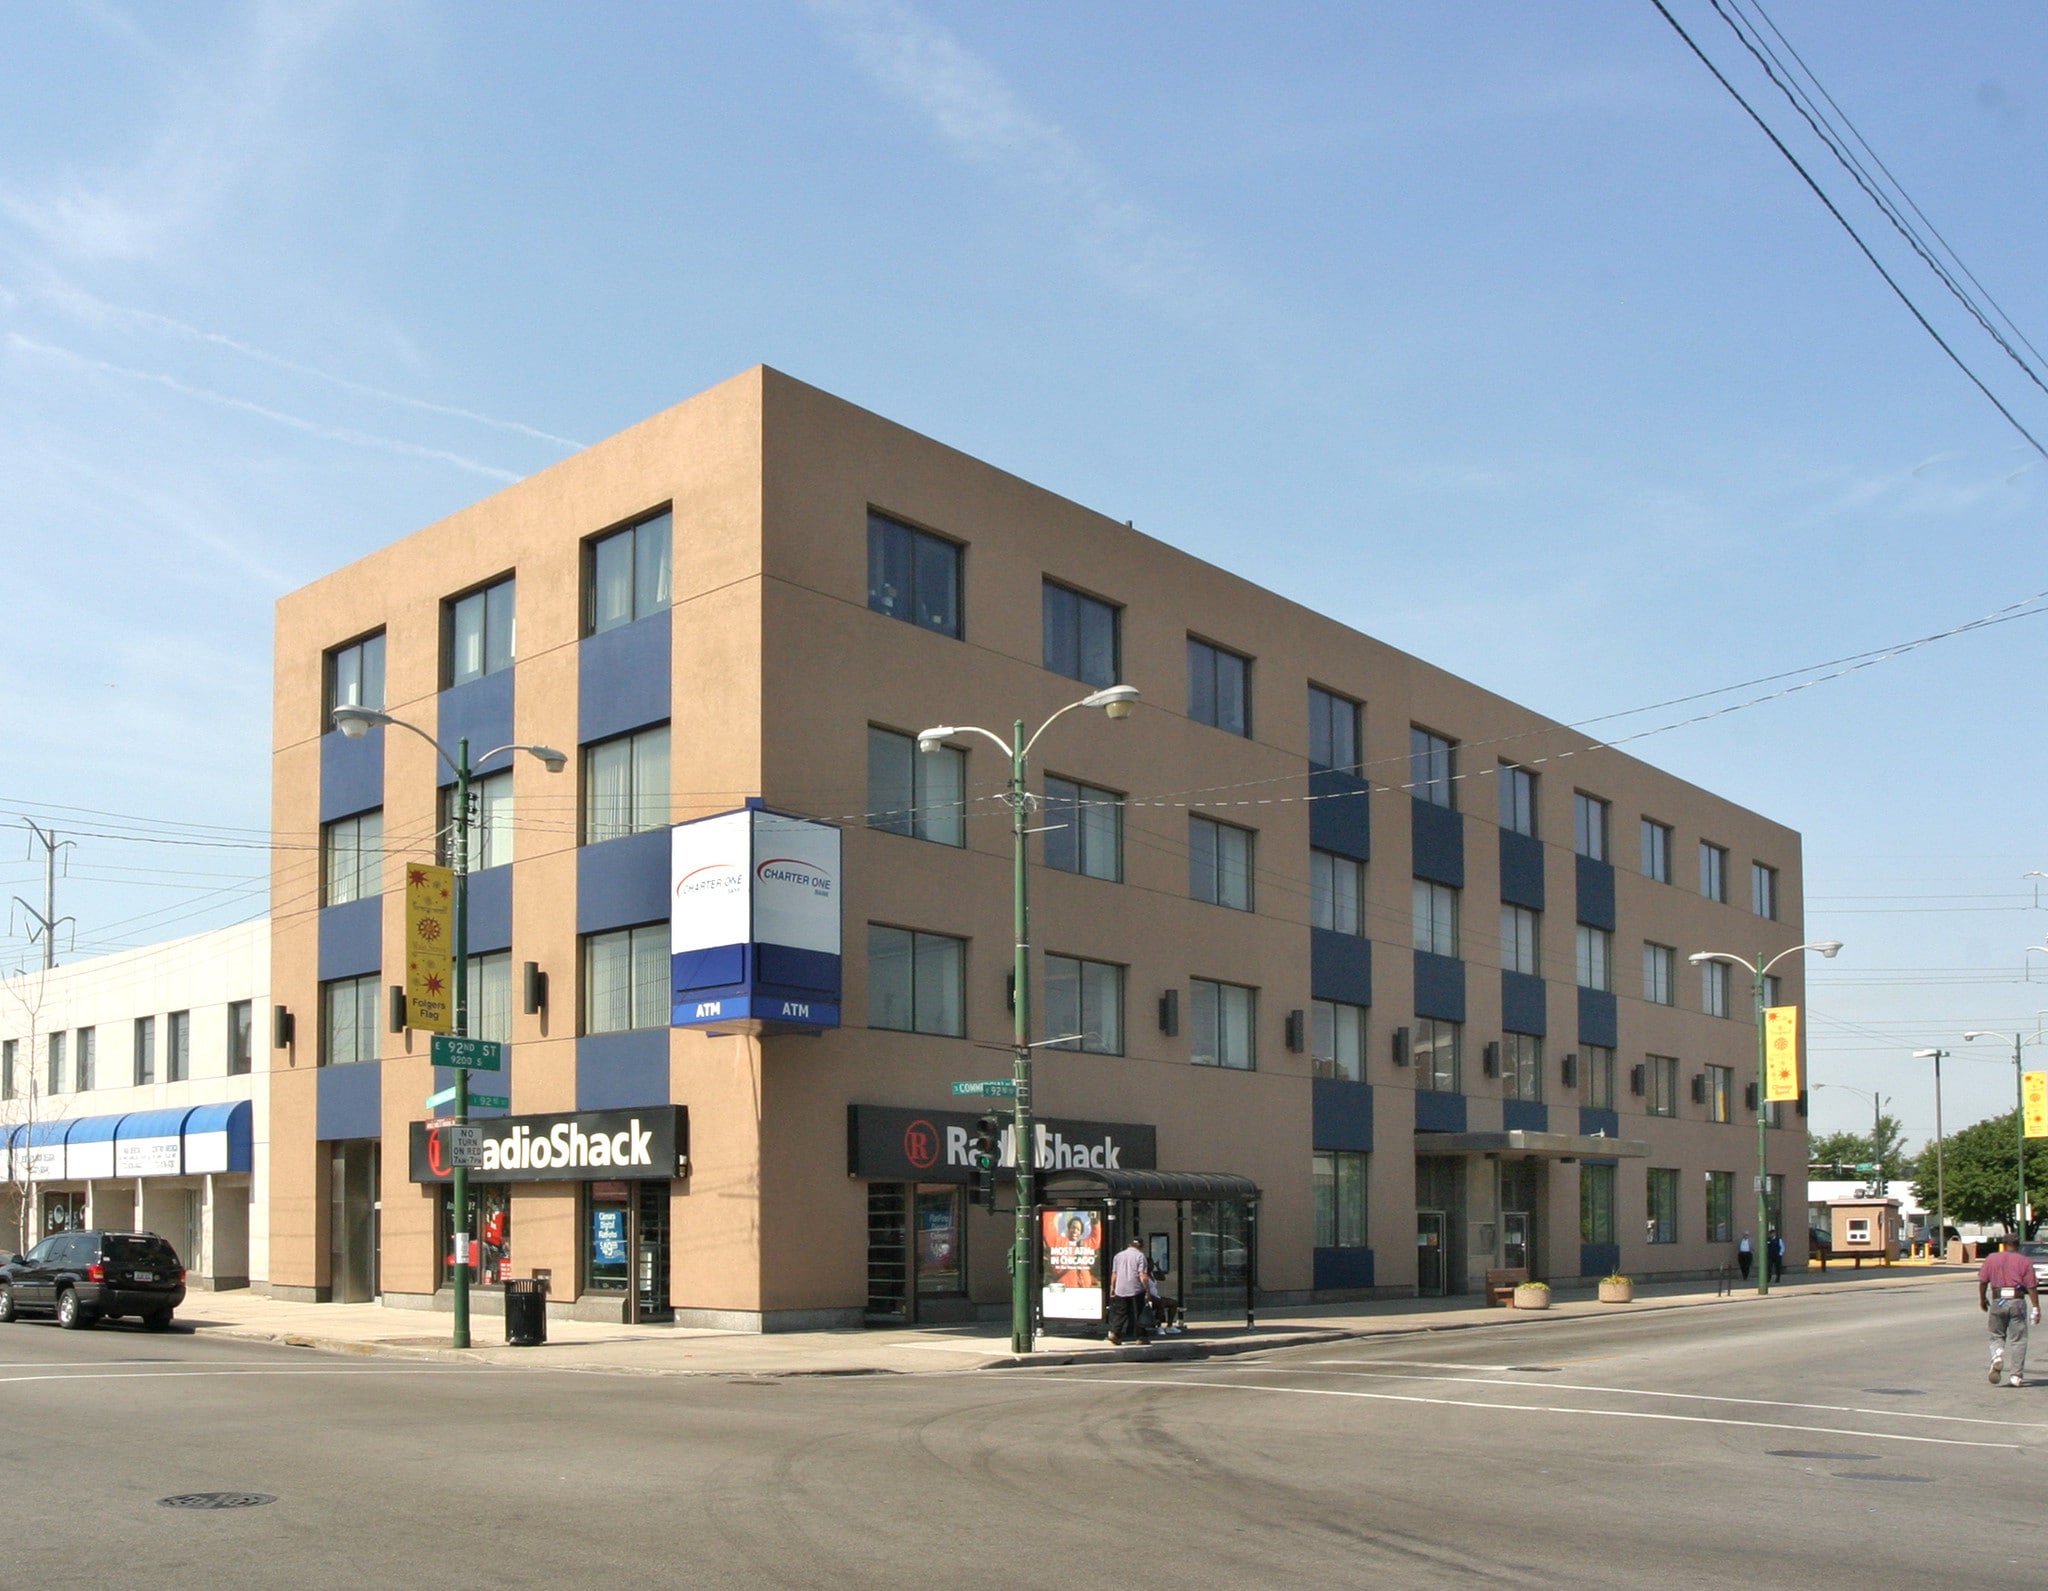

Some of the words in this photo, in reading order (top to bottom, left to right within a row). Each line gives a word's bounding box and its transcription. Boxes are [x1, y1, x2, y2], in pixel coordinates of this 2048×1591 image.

[683, 878, 722, 894] CHARTER
[725, 874, 743, 887] ONE
[763, 868, 809, 885] CHARTER
[811, 877, 831, 890] ONE
[412, 998, 446, 1010] Folgers
[696, 1002, 721, 1018] ATM
[782, 1002, 809, 1018] ATM
[420, 1009, 439, 1020] Flag
[435, 1042, 441, 1050] E
[448, 1041, 475, 1054] 92ND
[482, 1045, 497, 1056] ST
[450, 1055, 473, 1065] 9200
[476, 1058, 482, 1066] S
[460, 1129, 474, 1138] NO
[458, 1138, 478, 1146] TURN
[474, 1118, 653, 1171] adioShack
[946, 1126, 1121, 1169] RadShack
[453, 1146, 464, 1155] ON
[467, 1147, 481, 1156] RED
[1050, 1247, 1073, 1256] MOST
[1050, 1256, 1060, 1265] IN
[1061, 1256, 1095, 1265] CHICAGO
